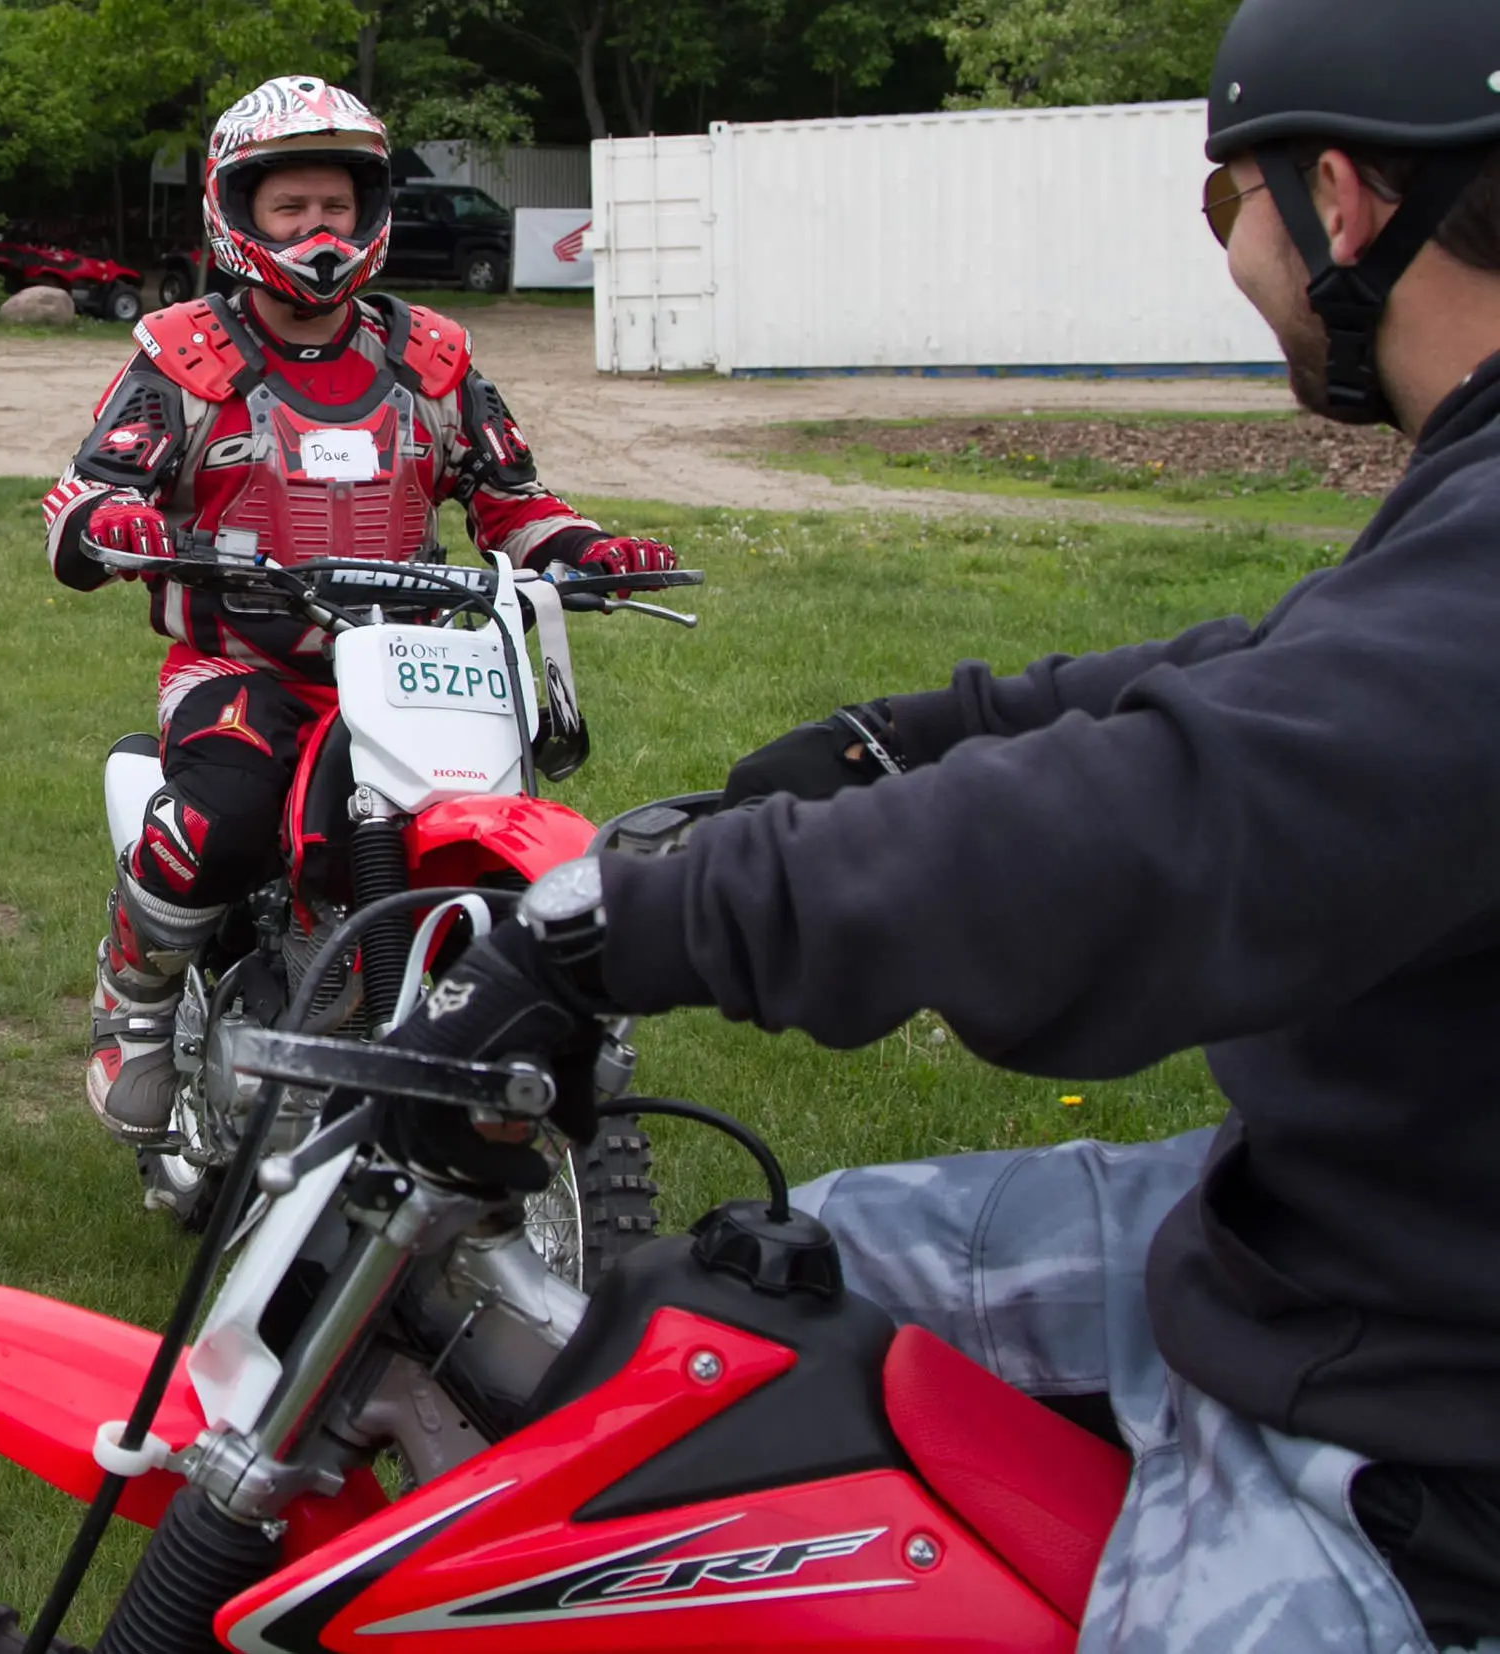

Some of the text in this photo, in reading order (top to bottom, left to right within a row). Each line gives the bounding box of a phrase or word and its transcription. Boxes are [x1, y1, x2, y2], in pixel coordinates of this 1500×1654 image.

[310, 444, 351, 462] Dave
[433, 768, 488, 781] HONDA
[558, 1526, 889, 1608] CRF
